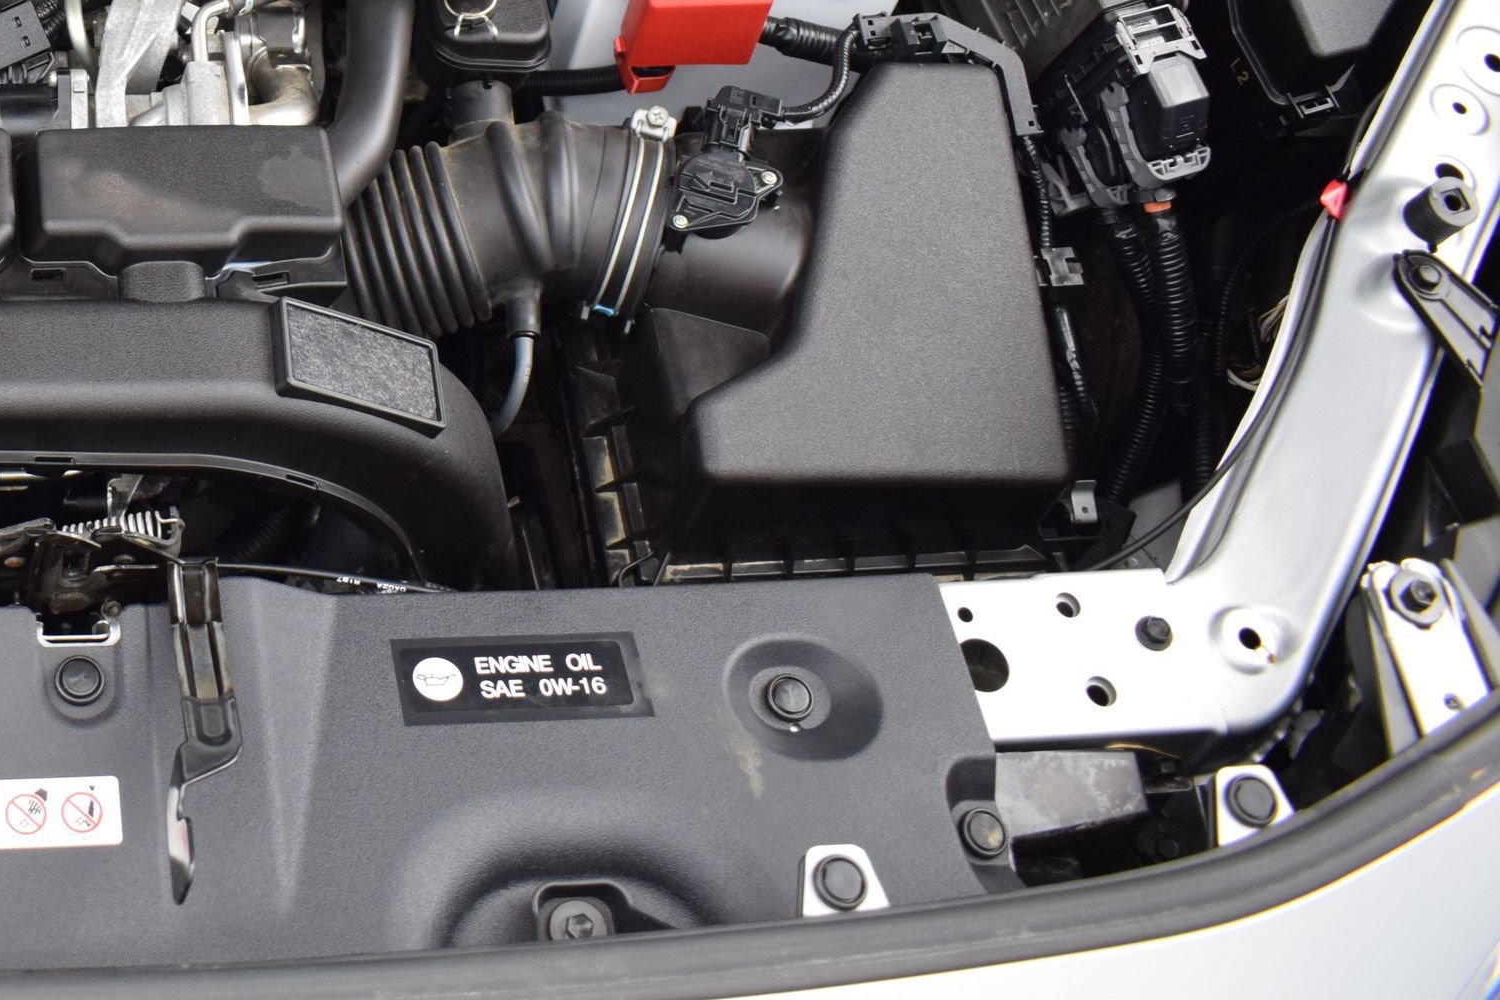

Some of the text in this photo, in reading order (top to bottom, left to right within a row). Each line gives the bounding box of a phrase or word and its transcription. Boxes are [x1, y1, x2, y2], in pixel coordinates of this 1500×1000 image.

[1229, 56, 1250, 86] L2
[474, 653, 603, 674] ENGINE OIL
[480, 676, 607, 699] SAE 0W-16
